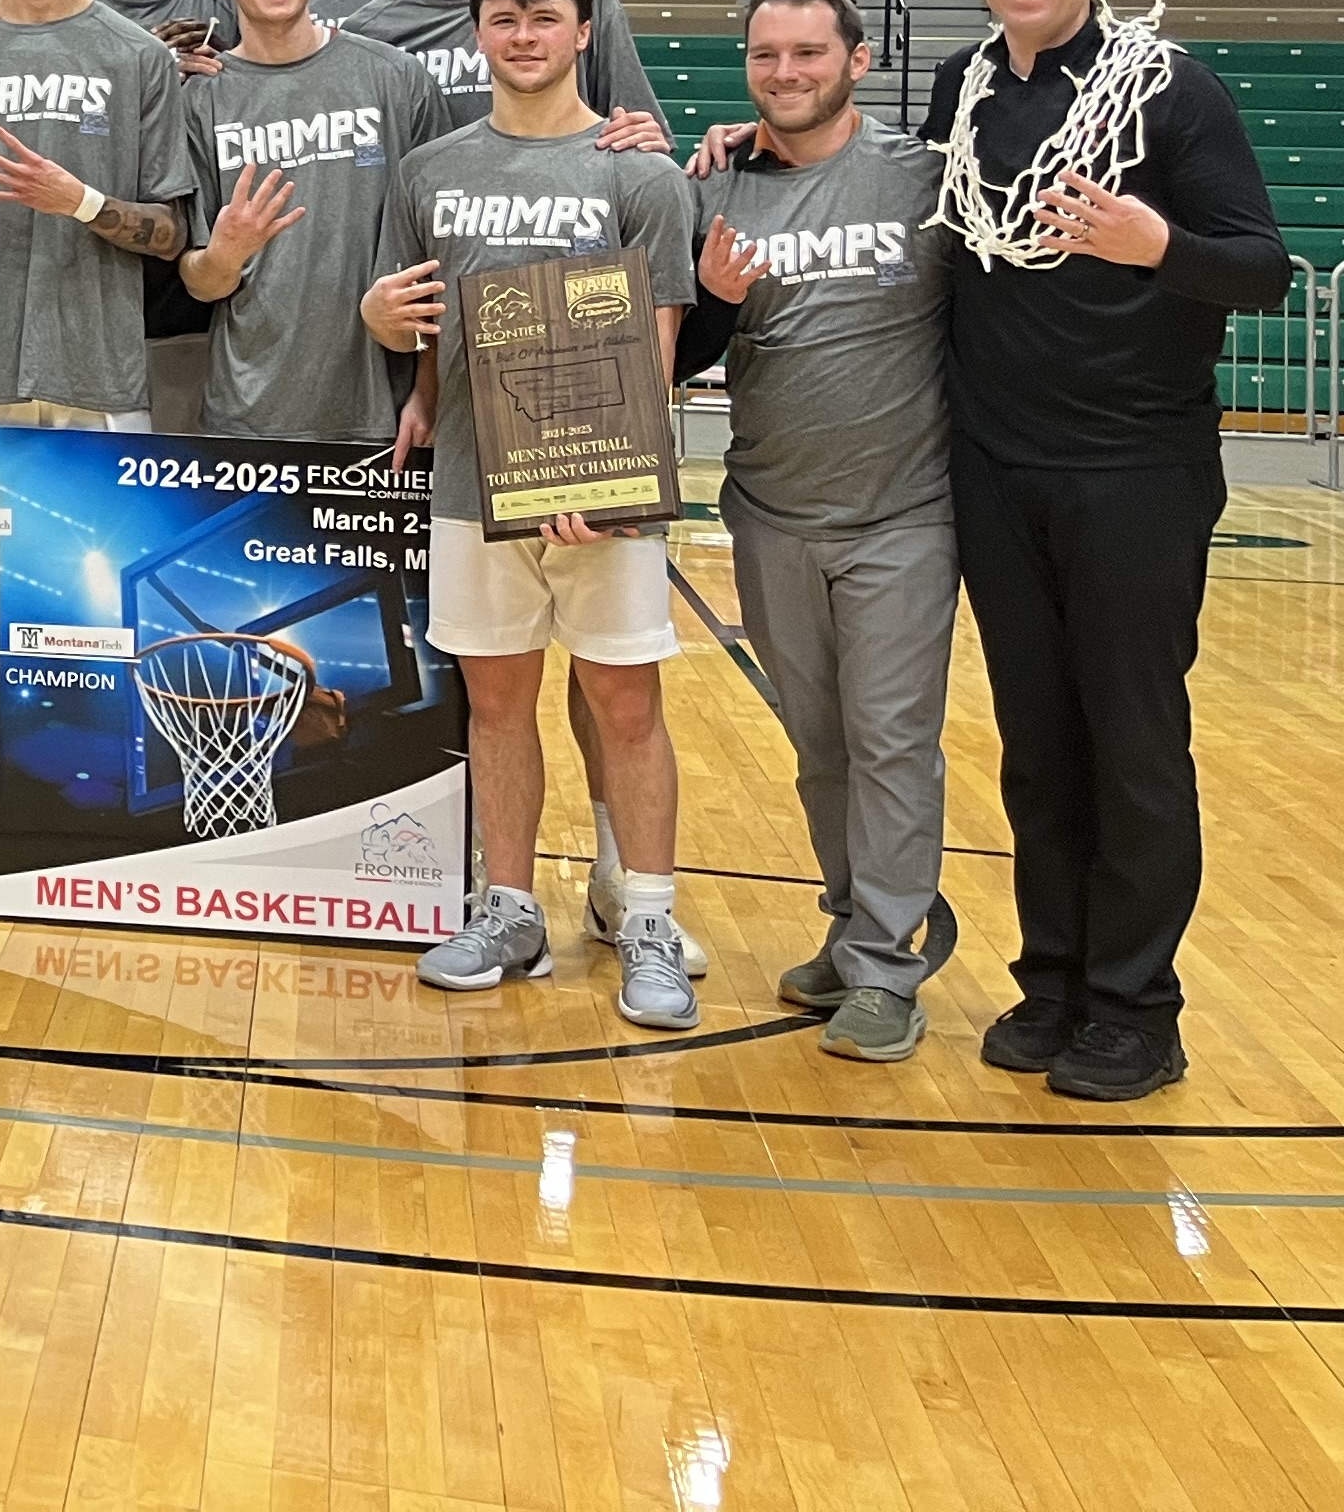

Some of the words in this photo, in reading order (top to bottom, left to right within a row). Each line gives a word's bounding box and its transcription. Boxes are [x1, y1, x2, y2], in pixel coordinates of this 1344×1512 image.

[215, 107, 381, 171] CHAMPS
[432, 196, 611, 239] CHAMPS
[730, 221, 906, 278] HAMPS
[475, 323, 546, 344] FRONTIER
[507, 447, 546, 465] MEN'S
[549, 436, 633, 460] BASKETBALL
[116, 457, 301, 495] 2024-2025
[487, 464, 576, 487] TOURNAMENT
[579, 454, 659, 477] CHAMPIONS
[367, 489, 432, 501] CONFEREN
[313, 507, 395, 533] March
[244, 539, 316, 564] Great
[325, 543, 395, 573] Falls,
[405, 548, 430, 570] M
[5, 668, 116, 691] CHAMPION
[354, 862, 443, 881] FRONTIER
[37, 875, 161, 914] MEN'S
[176, 886, 456, 936] BASKETBALL
